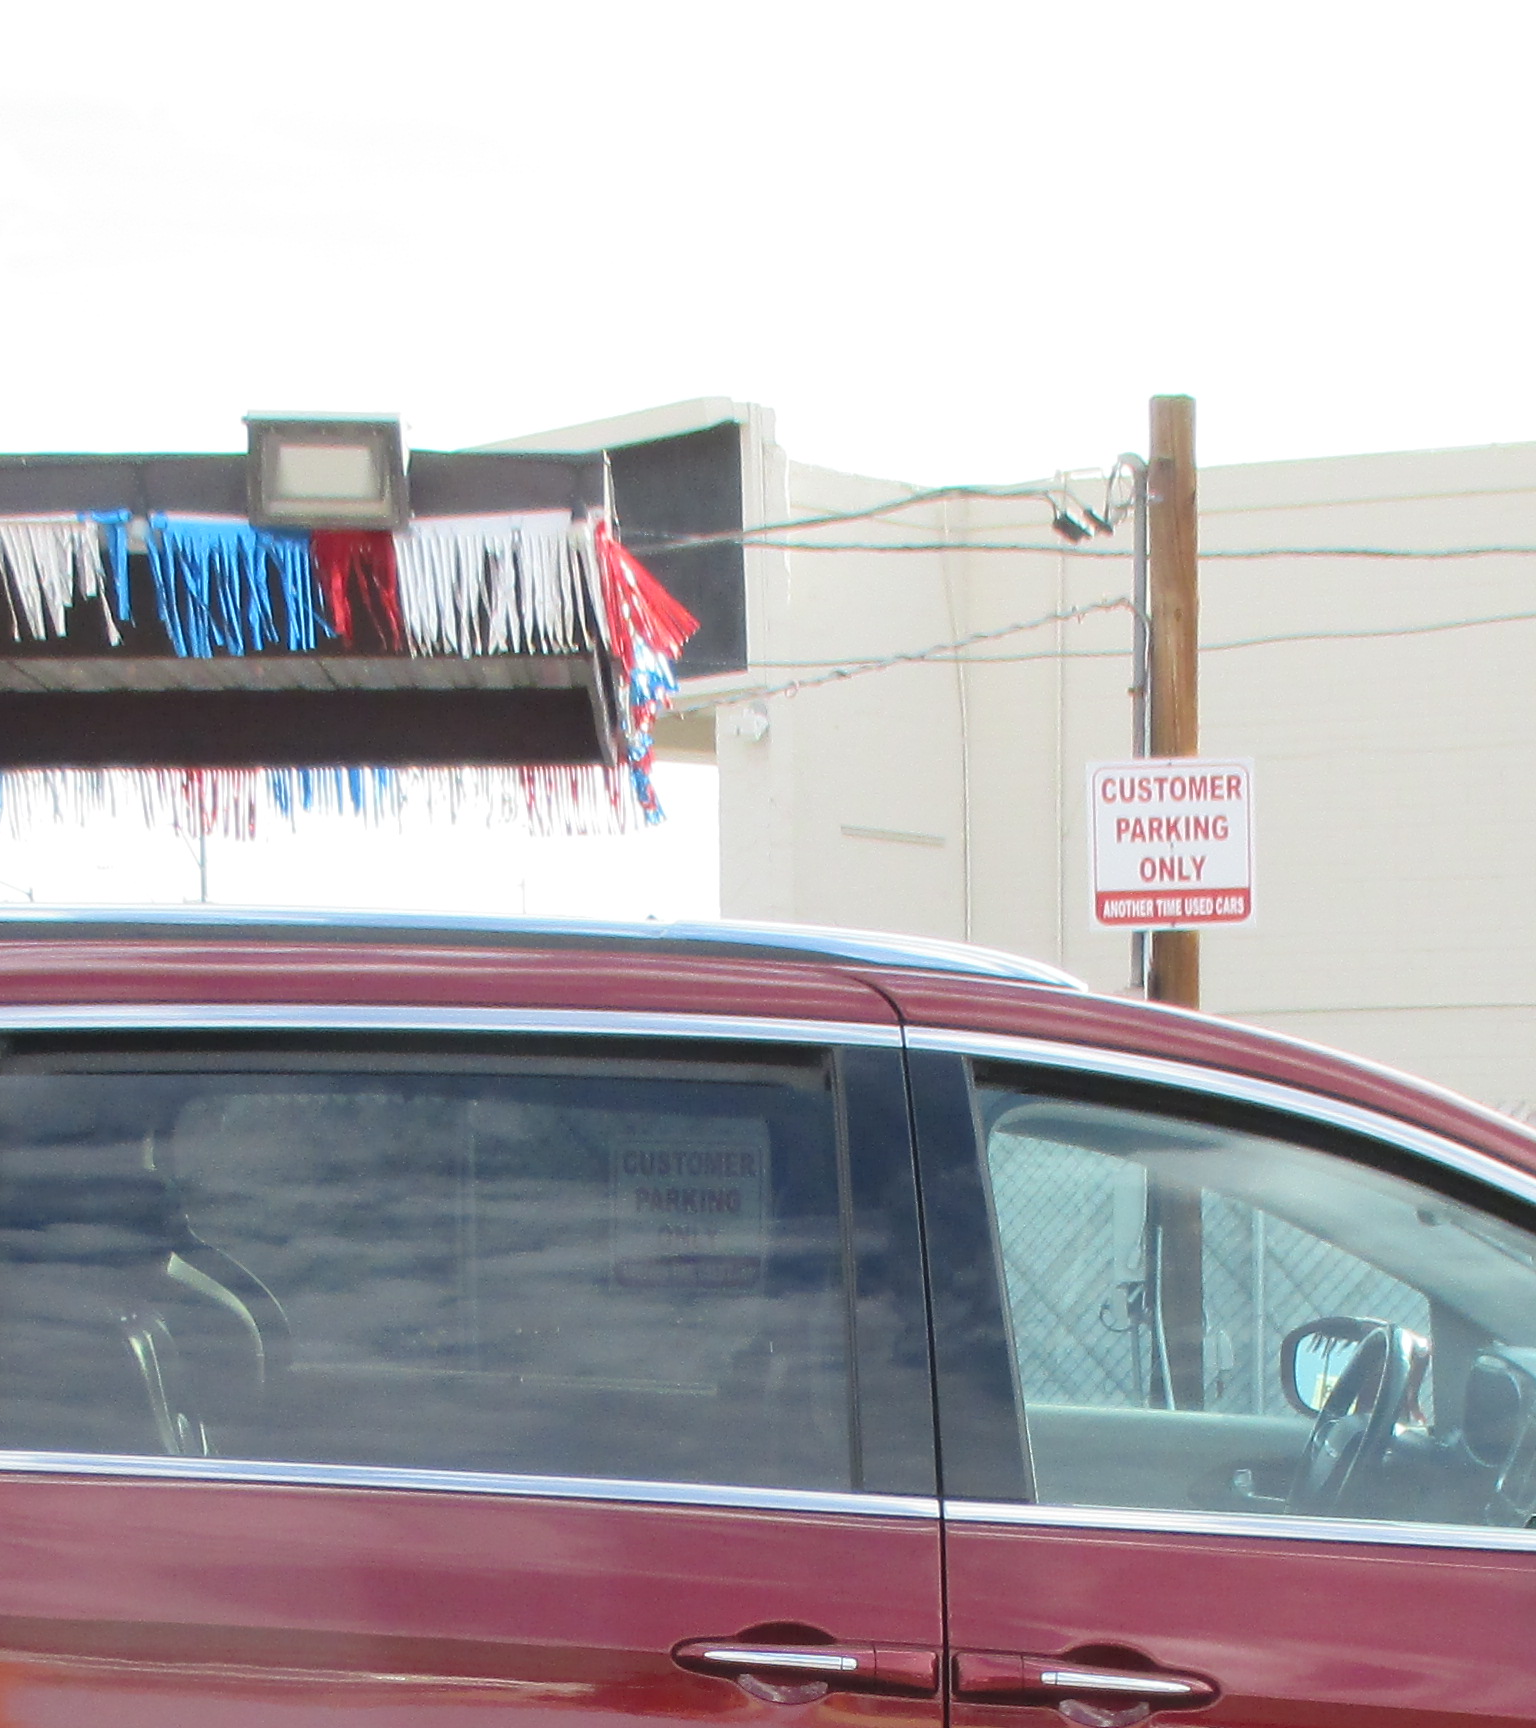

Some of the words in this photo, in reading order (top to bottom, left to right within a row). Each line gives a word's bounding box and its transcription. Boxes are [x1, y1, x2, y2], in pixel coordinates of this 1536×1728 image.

[1101, 774, 1242, 803] CUSTOMER
[1116, 815, 1229, 843] PARKING
[1139, 856, 1207, 882] ONLY
[1103, 899, 1154, 918] ANOTHER
[1157, 898, 1182, 917] TIME
[1184, 897, 1213, 916] USED
[1216, 896, 1244, 915] CARS
[623, 1150, 756, 1177] CUSTOMER
[635, 1187, 741, 1214] PARKING
